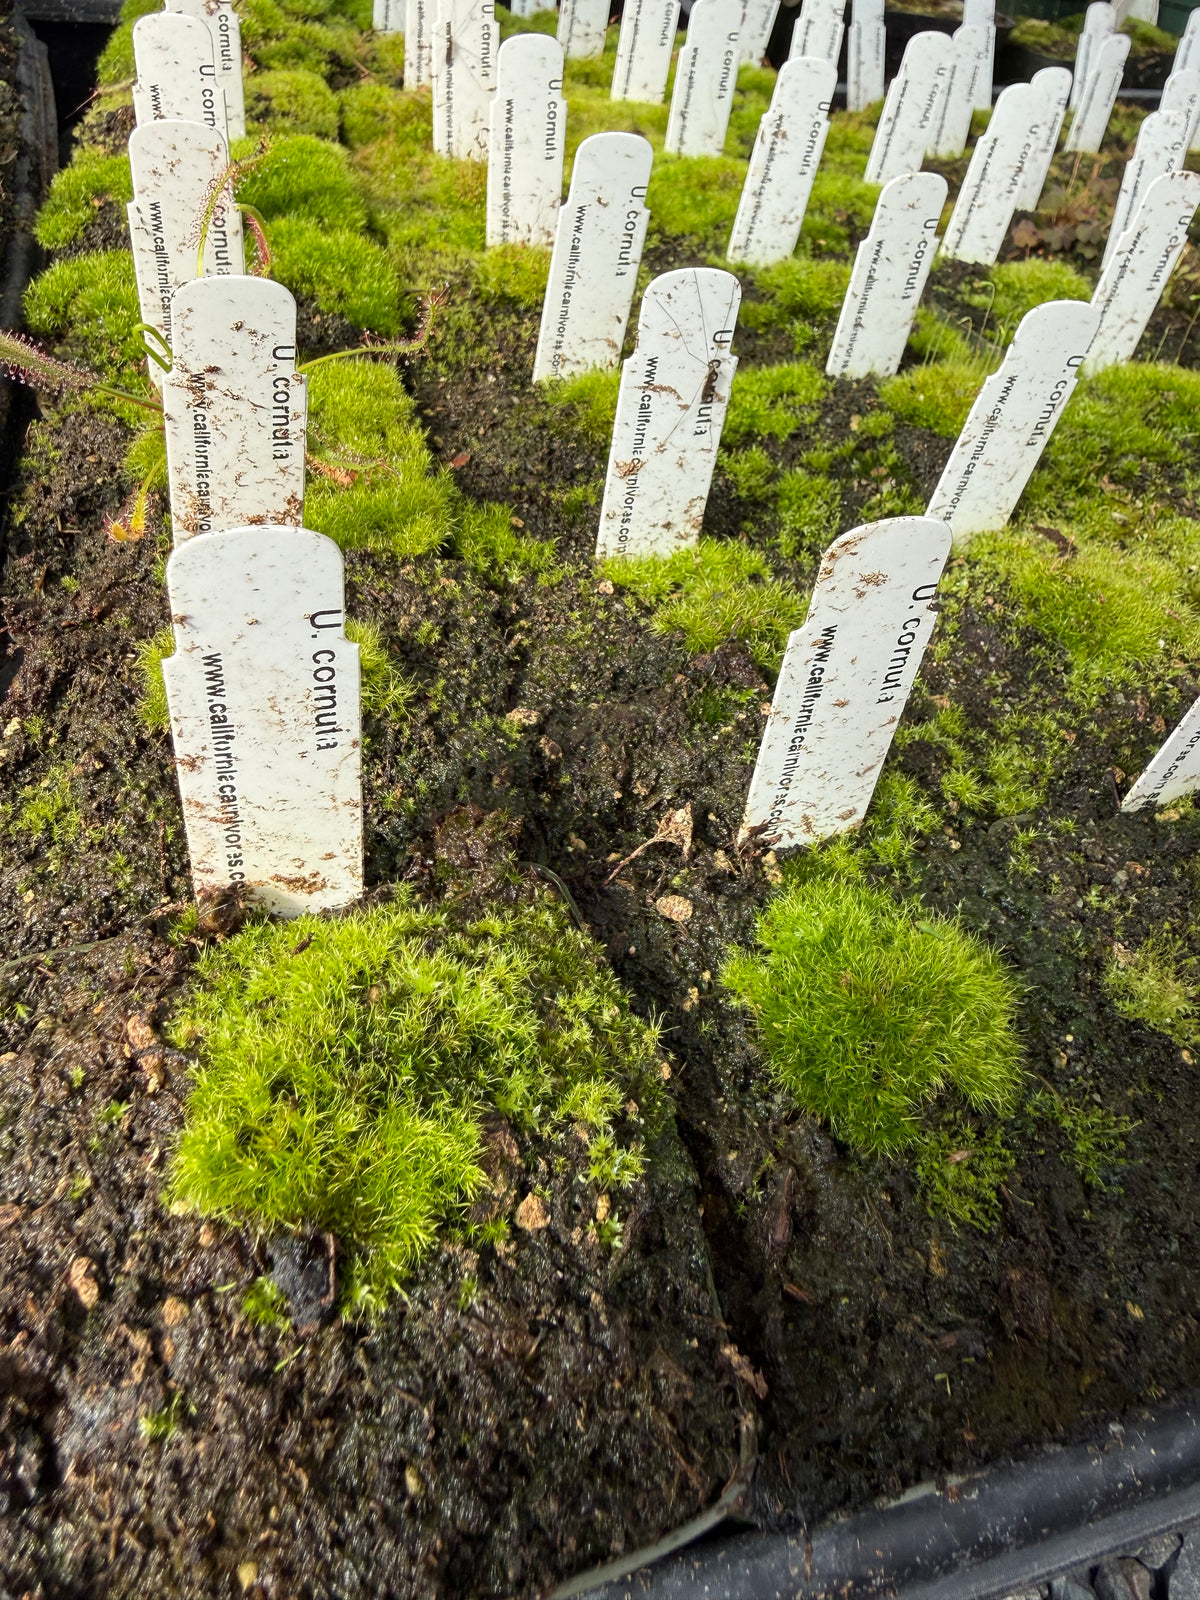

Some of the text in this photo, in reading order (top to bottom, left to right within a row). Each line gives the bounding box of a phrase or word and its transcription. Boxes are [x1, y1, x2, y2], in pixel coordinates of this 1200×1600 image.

[218, 14, 234, 71] cornuta
[481, 4, 494, 78] U. cornuta
[717, 49, 734, 100] cornuta
[200, 65, 216, 131] U. corn
[545, 79, 563, 161] U. cornuta
[798, 101, 831, 176] U. cornuta
[615, 186, 648, 277] U. cornuta
[901, 218, 939, 301] U. cornuta
[1146, 215, 1192, 292] U. cornuta
[711, 329, 733, 350] U.
[272, 345, 294, 461] U. cornuta
[1026, 355, 1085, 447] U. cornuta
[310, 609, 344, 751] U. cornuta
[876, 583, 938, 704] U. cornuta
